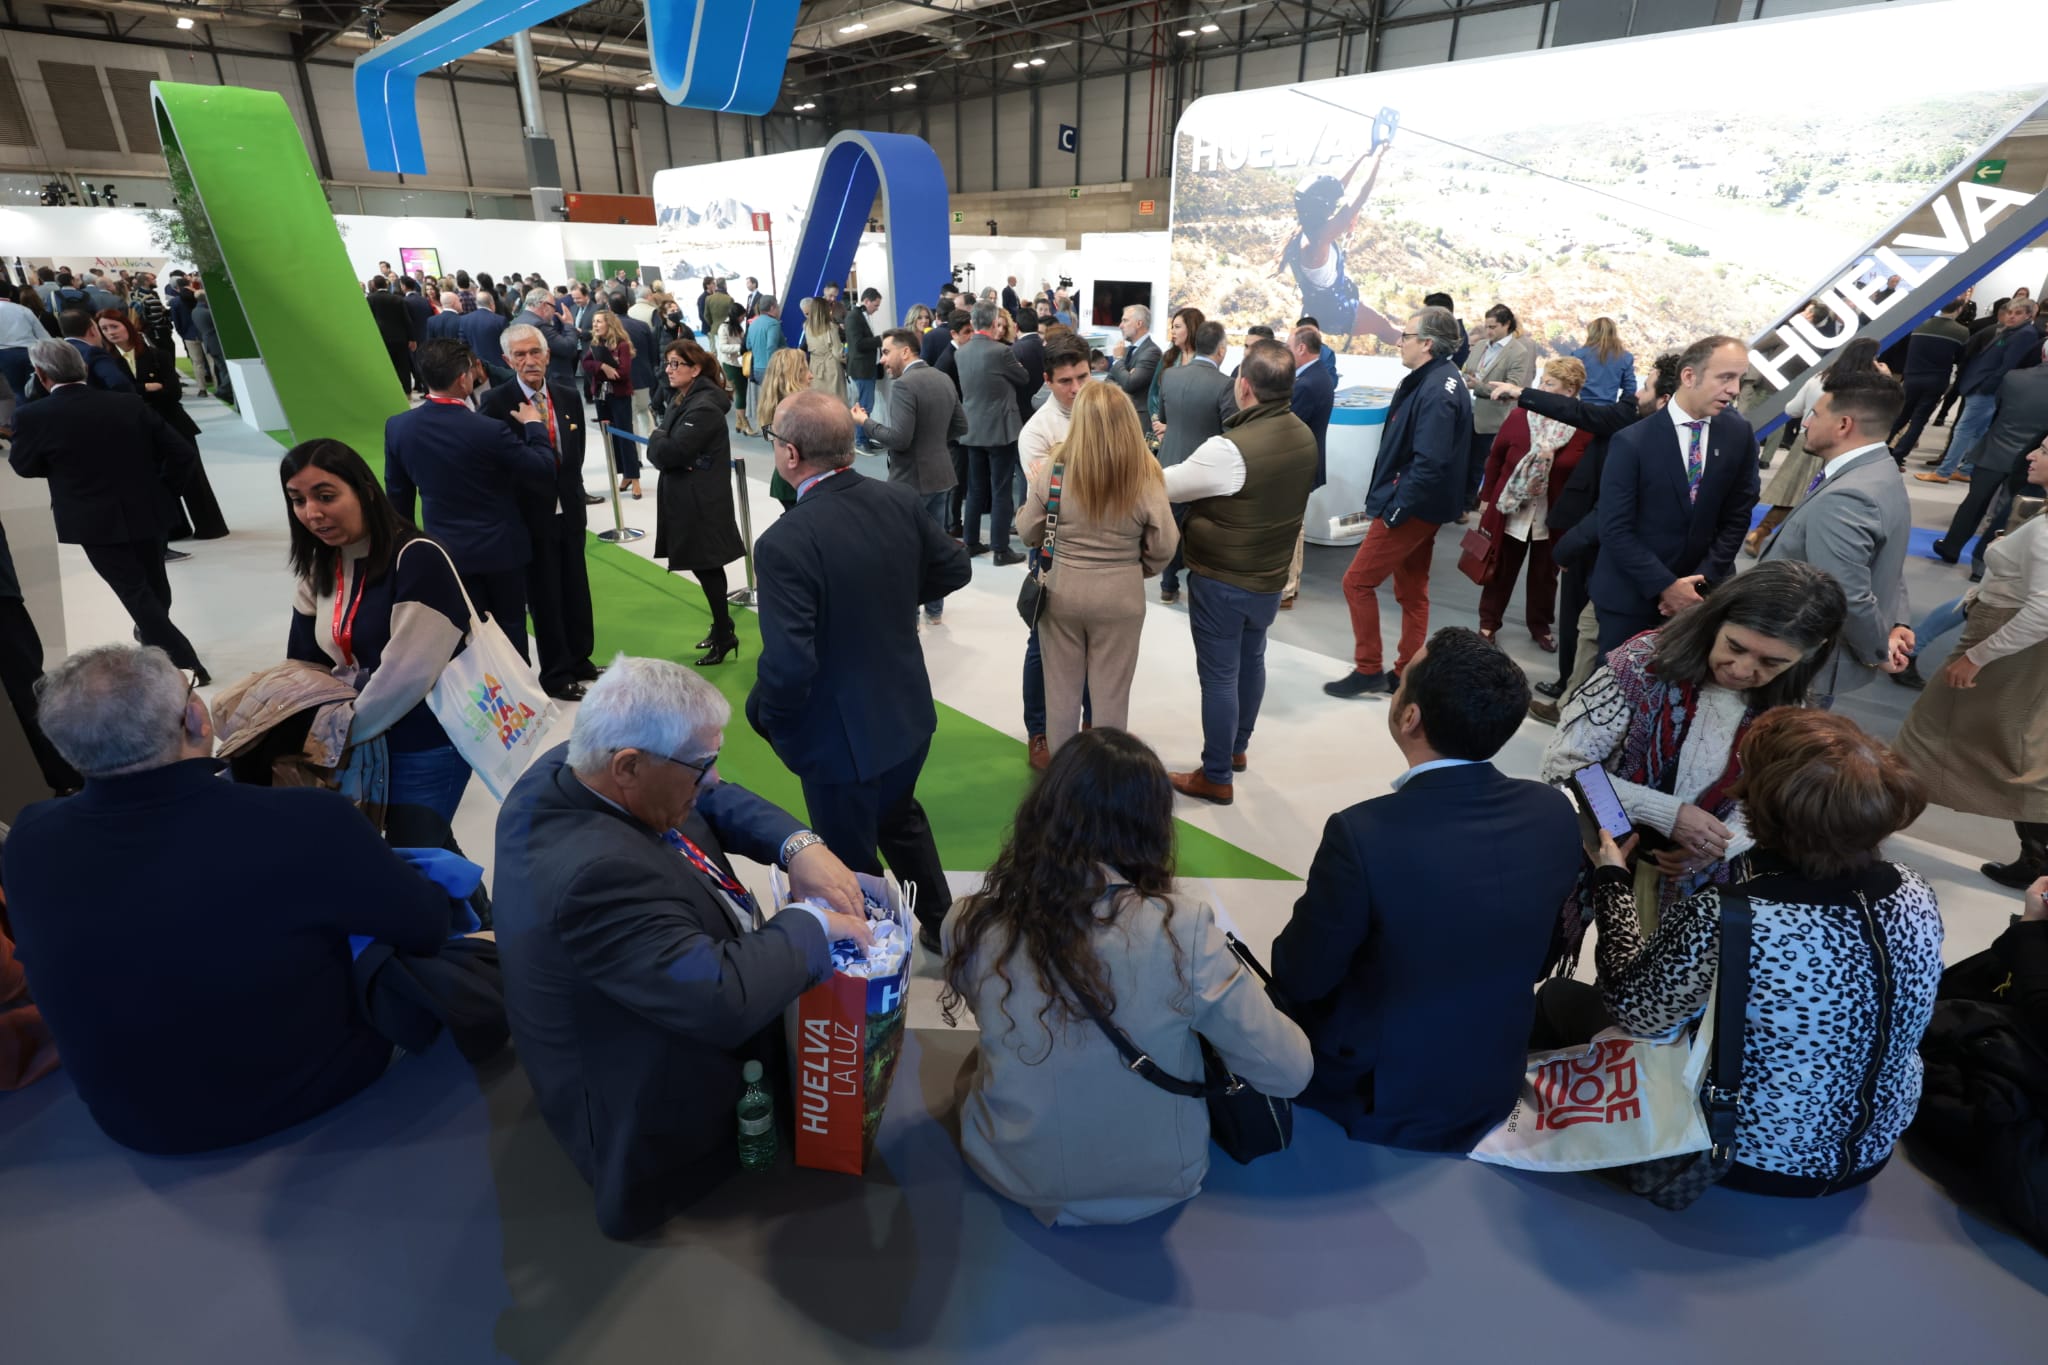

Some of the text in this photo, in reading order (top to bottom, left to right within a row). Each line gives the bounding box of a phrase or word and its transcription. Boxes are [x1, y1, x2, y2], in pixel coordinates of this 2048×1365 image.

[1062, 129, 1073, 149] C
[1191, 122, 1355, 173] HUELVA
[1749, 181, 2038, 391] HUELVA
[802, 1019, 831, 1135] HUELVA
